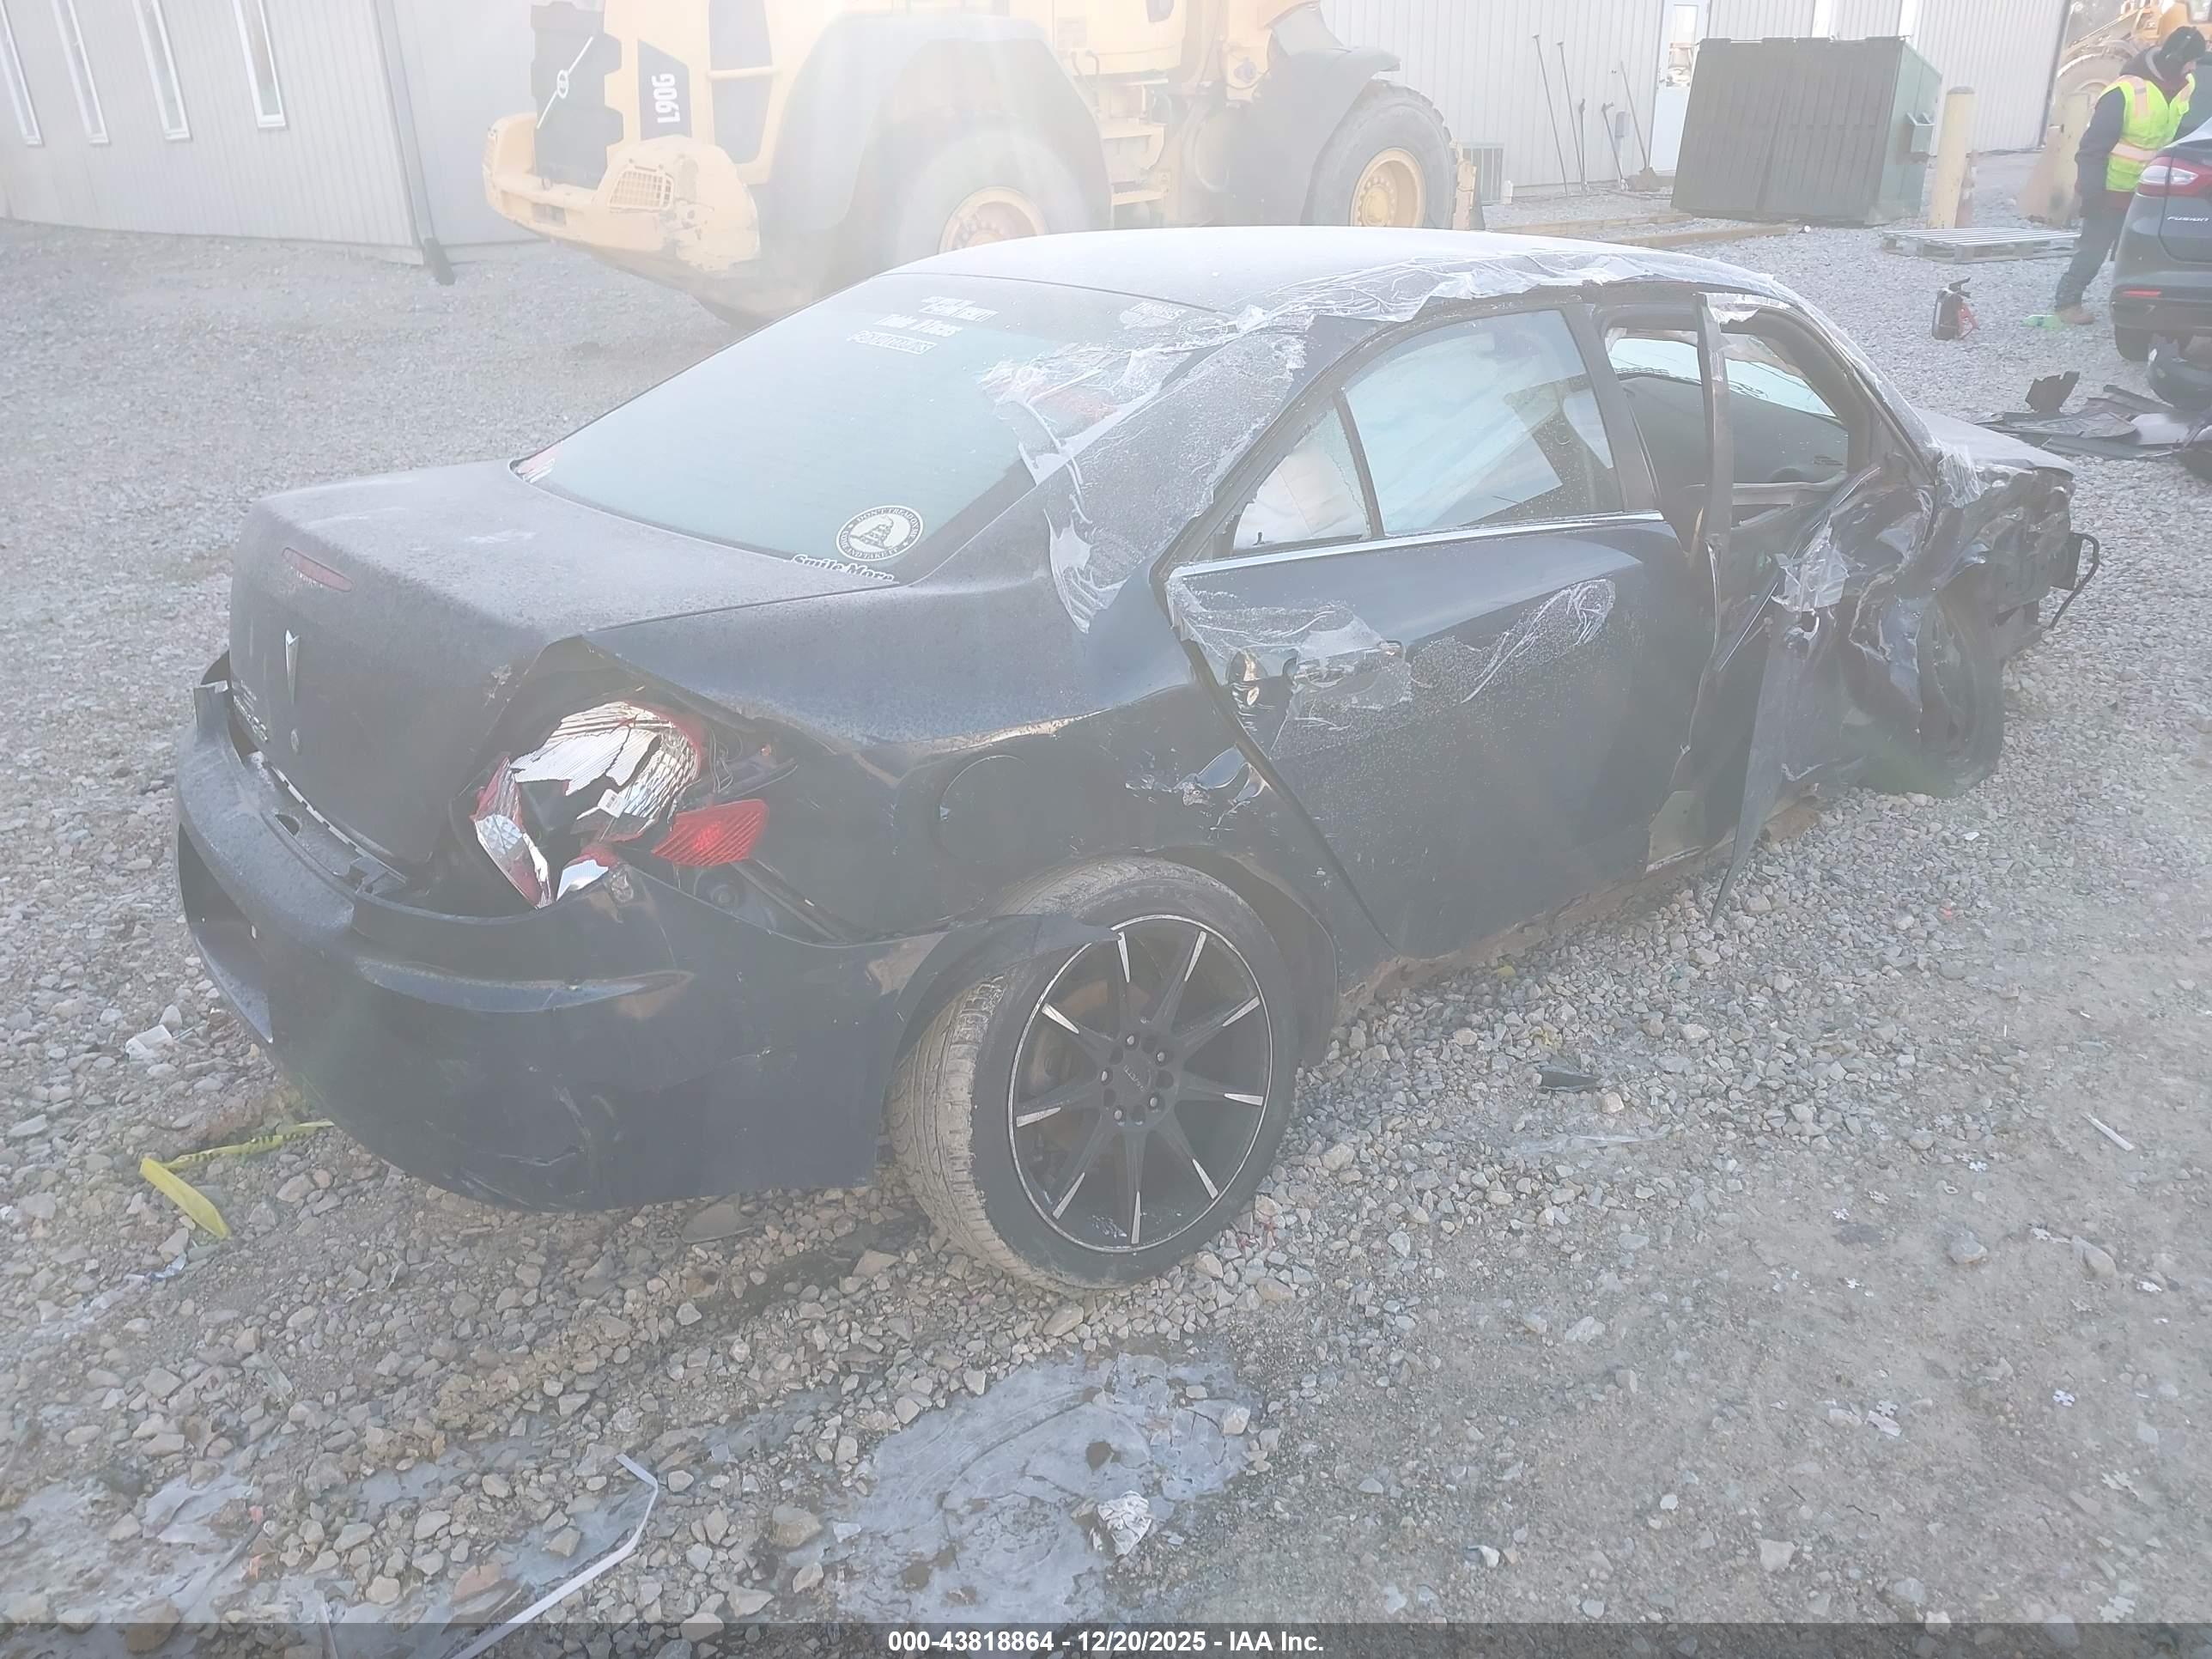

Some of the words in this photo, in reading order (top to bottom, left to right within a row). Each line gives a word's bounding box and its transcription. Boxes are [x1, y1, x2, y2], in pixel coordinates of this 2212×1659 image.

[651, 73, 681, 124] L90G
[888, 507, 914, 520] TREAD
[863, 551, 887, 560] TAKE
[792, 554, 843, 572] Smile
[845, 563, 895, 581] More
